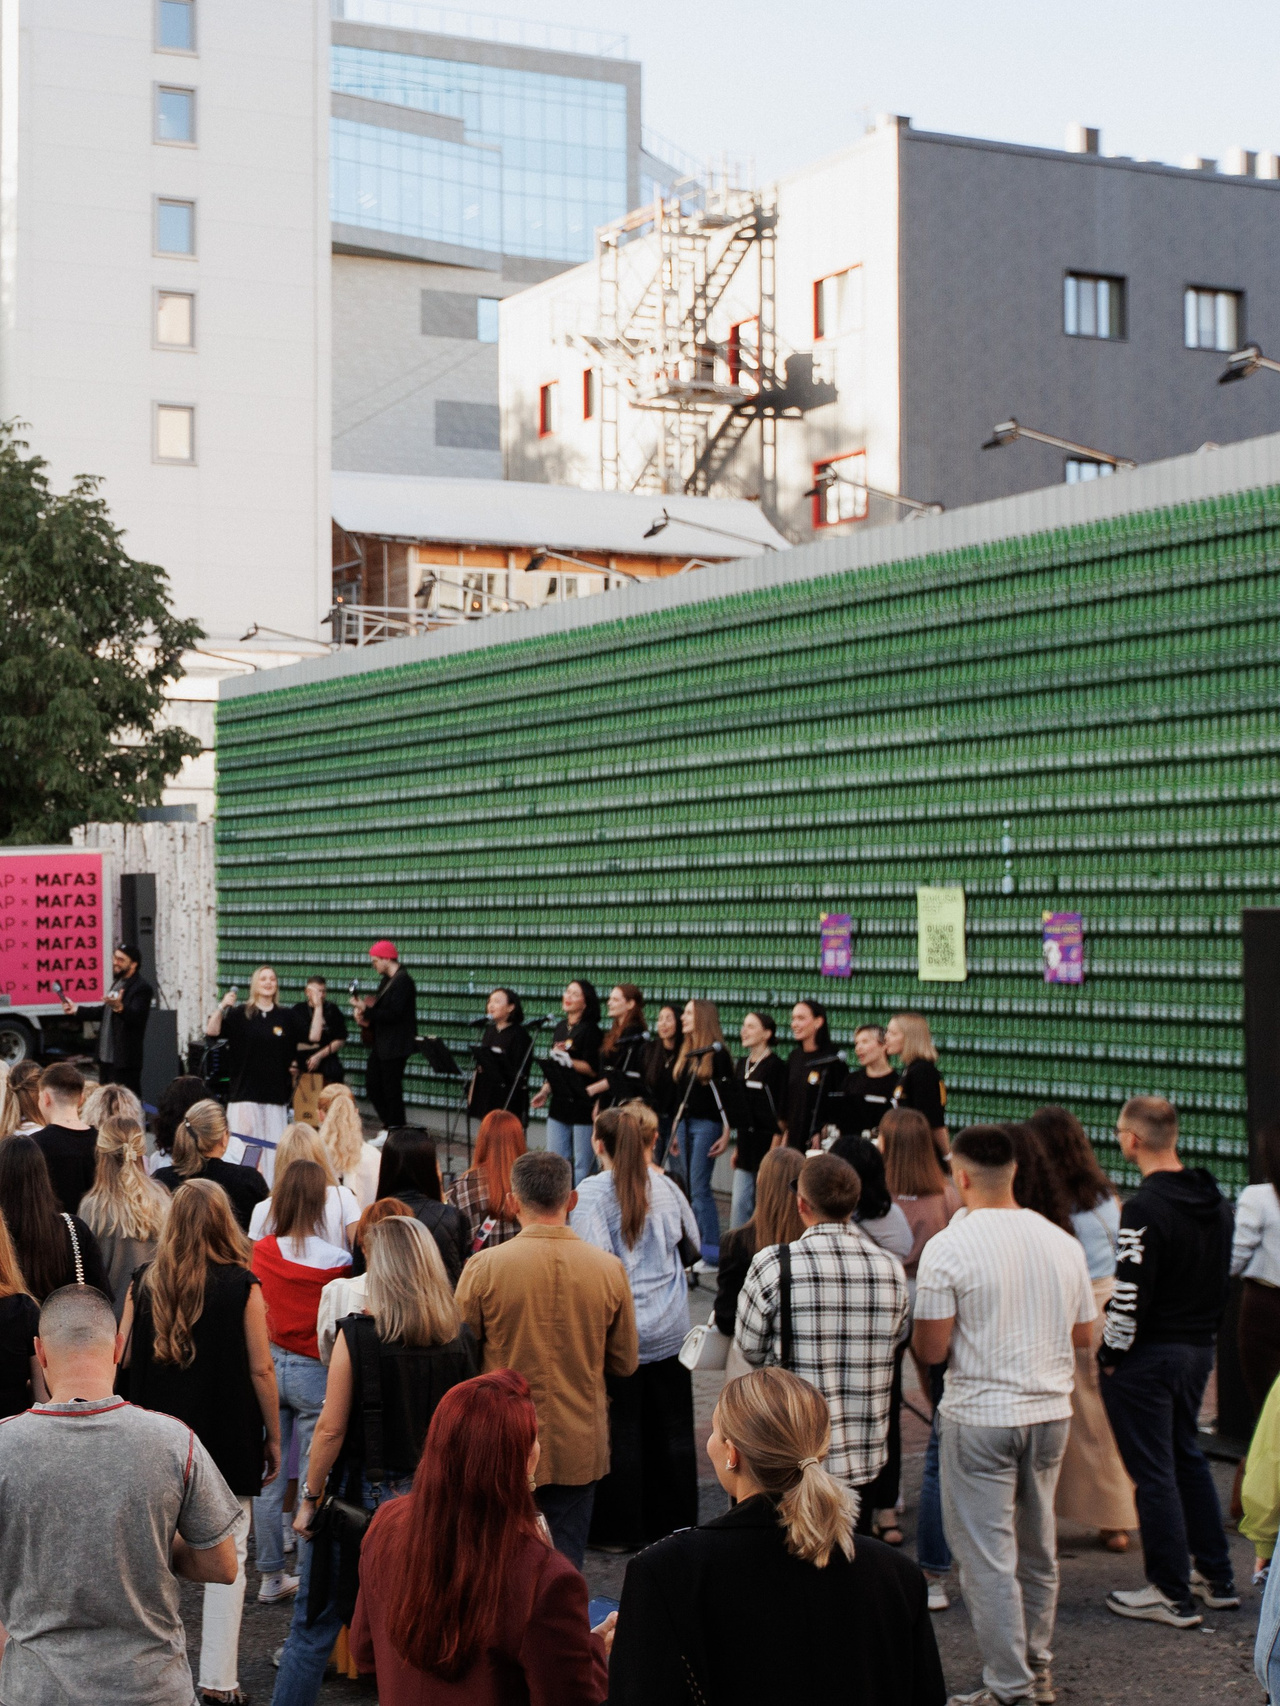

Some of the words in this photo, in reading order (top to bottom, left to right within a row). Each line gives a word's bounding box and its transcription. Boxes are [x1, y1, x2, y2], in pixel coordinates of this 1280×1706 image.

[35, 873, 96, 887] МАГАЗ
[36, 894, 97, 908] МАГАЗ
[36, 915, 97, 929] МАГАЗ
[36, 936, 97, 950] МАГАЗ
[37, 957, 98, 972] МАГАЗ
